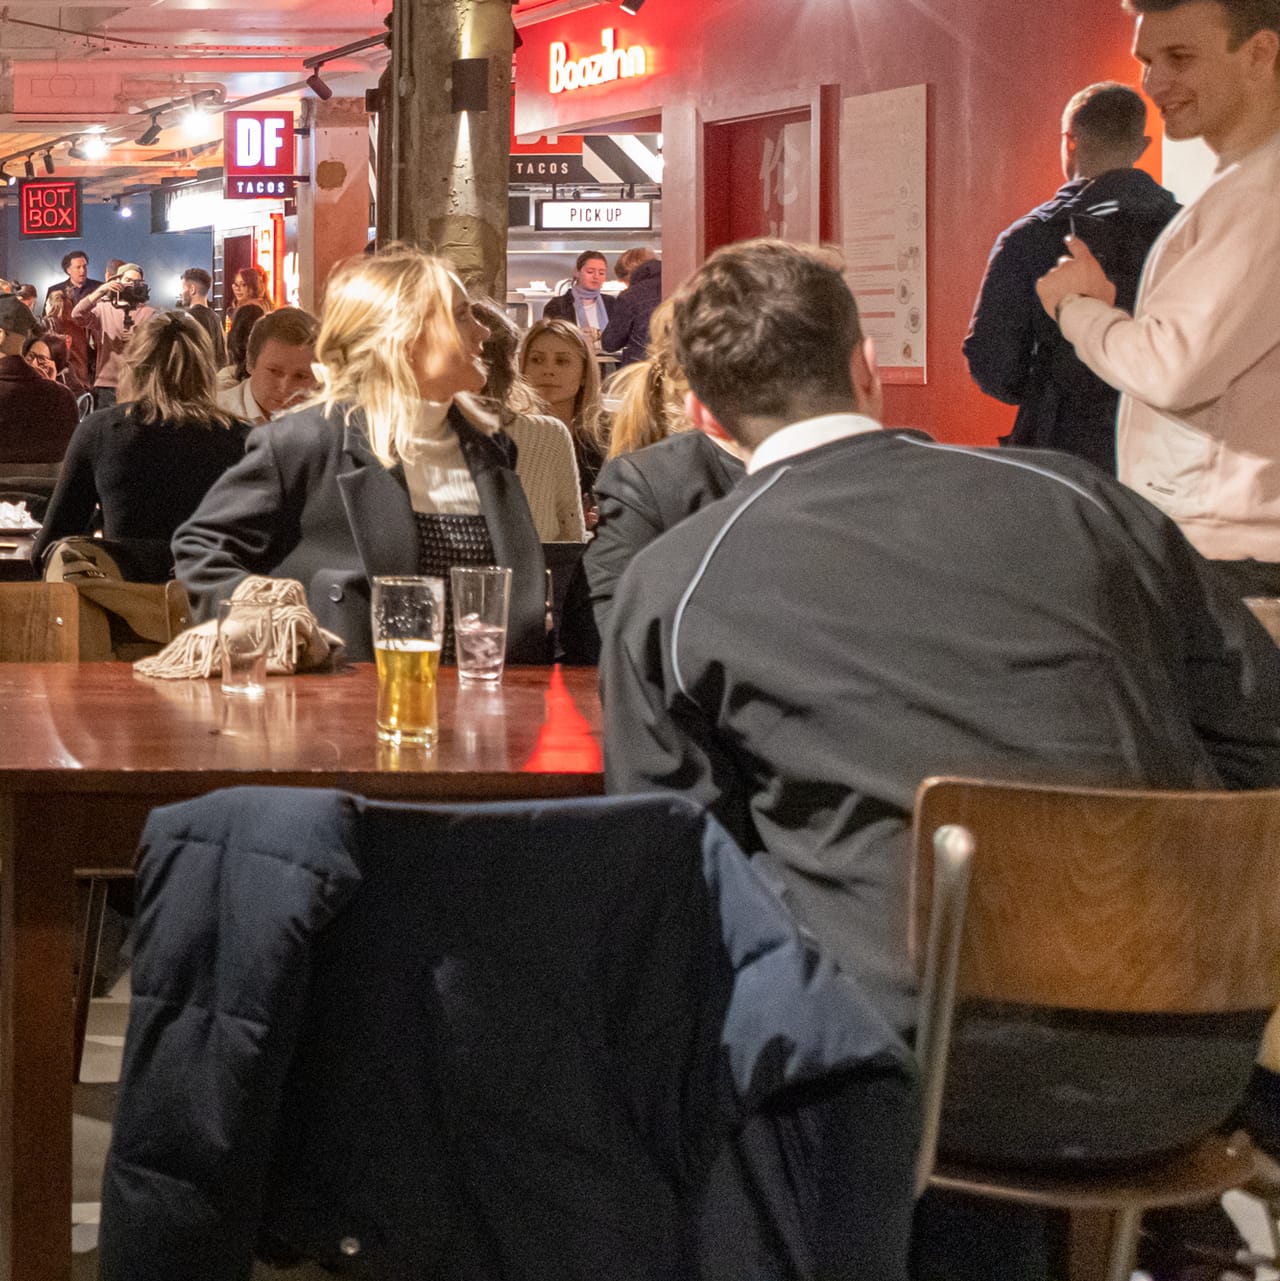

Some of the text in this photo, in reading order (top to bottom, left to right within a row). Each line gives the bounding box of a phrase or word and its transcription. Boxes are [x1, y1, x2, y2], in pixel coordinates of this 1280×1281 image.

[235, 117, 286, 168] DF
[515, 162, 569, 175] TACOS
[236, 181, 286, 194] TACOS
[28, 188, 71, 208] HOT
[28, 208, 72, 228] BOX
[569, 207, 623, 223] PICK UP
